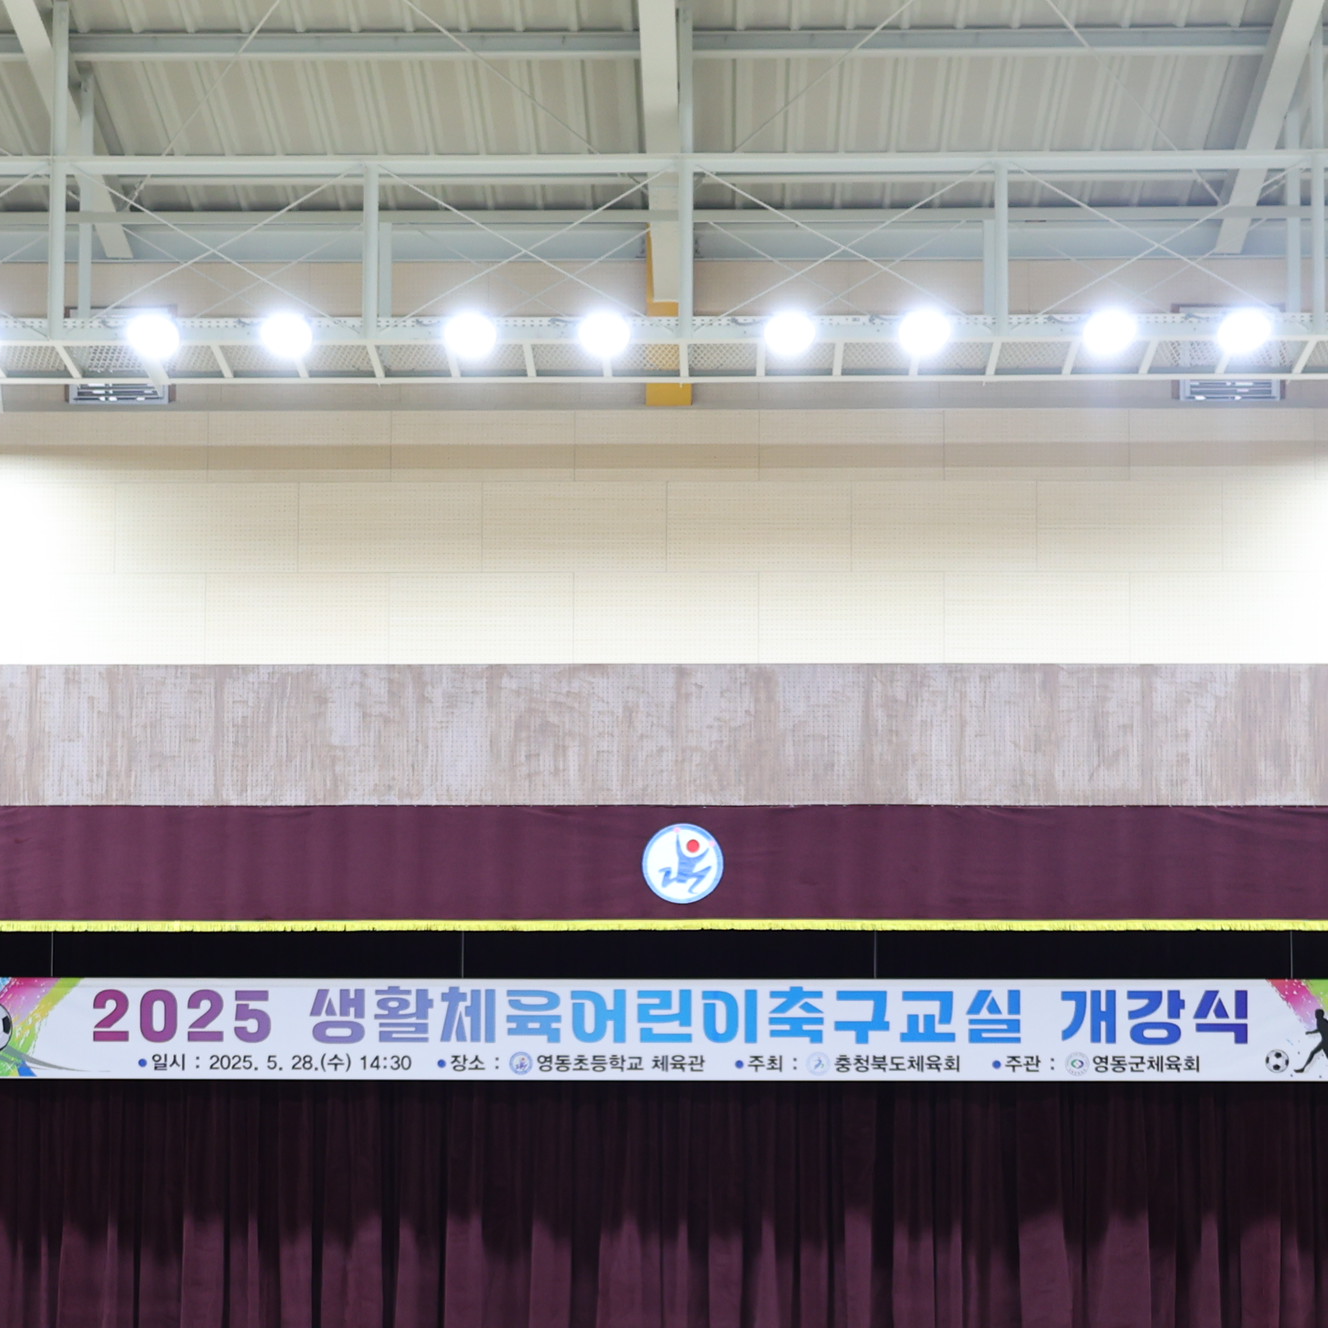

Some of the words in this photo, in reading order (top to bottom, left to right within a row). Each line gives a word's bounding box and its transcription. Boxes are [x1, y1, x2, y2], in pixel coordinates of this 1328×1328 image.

[93, 989, 271, 1043] 2025
[310, 986, 1021, 1045] 생활체육어린이축구교실
[1061, 989, 1248, 1046] 개강식
[152, 1054, 186, 1071] 일시
[209, 1055, 259, 1071] 2025.
[267, 1055, 283, 1071] 5.
[360, 1055, 412, 1071] 14:30
[450, 1055, 486, 1072] 장소
[536, 1055, 644, 1072] 영동초등학교
[652, 1055, 706, 1072] 체육관
[747, 1055, 783, 1073] 주최
[834, 1055, 961, 1073] 충청북도체육회
[1005, 1055, 1041, 1073] 주관
[1092, 1055, 1201, 1074] 영동군체육회
